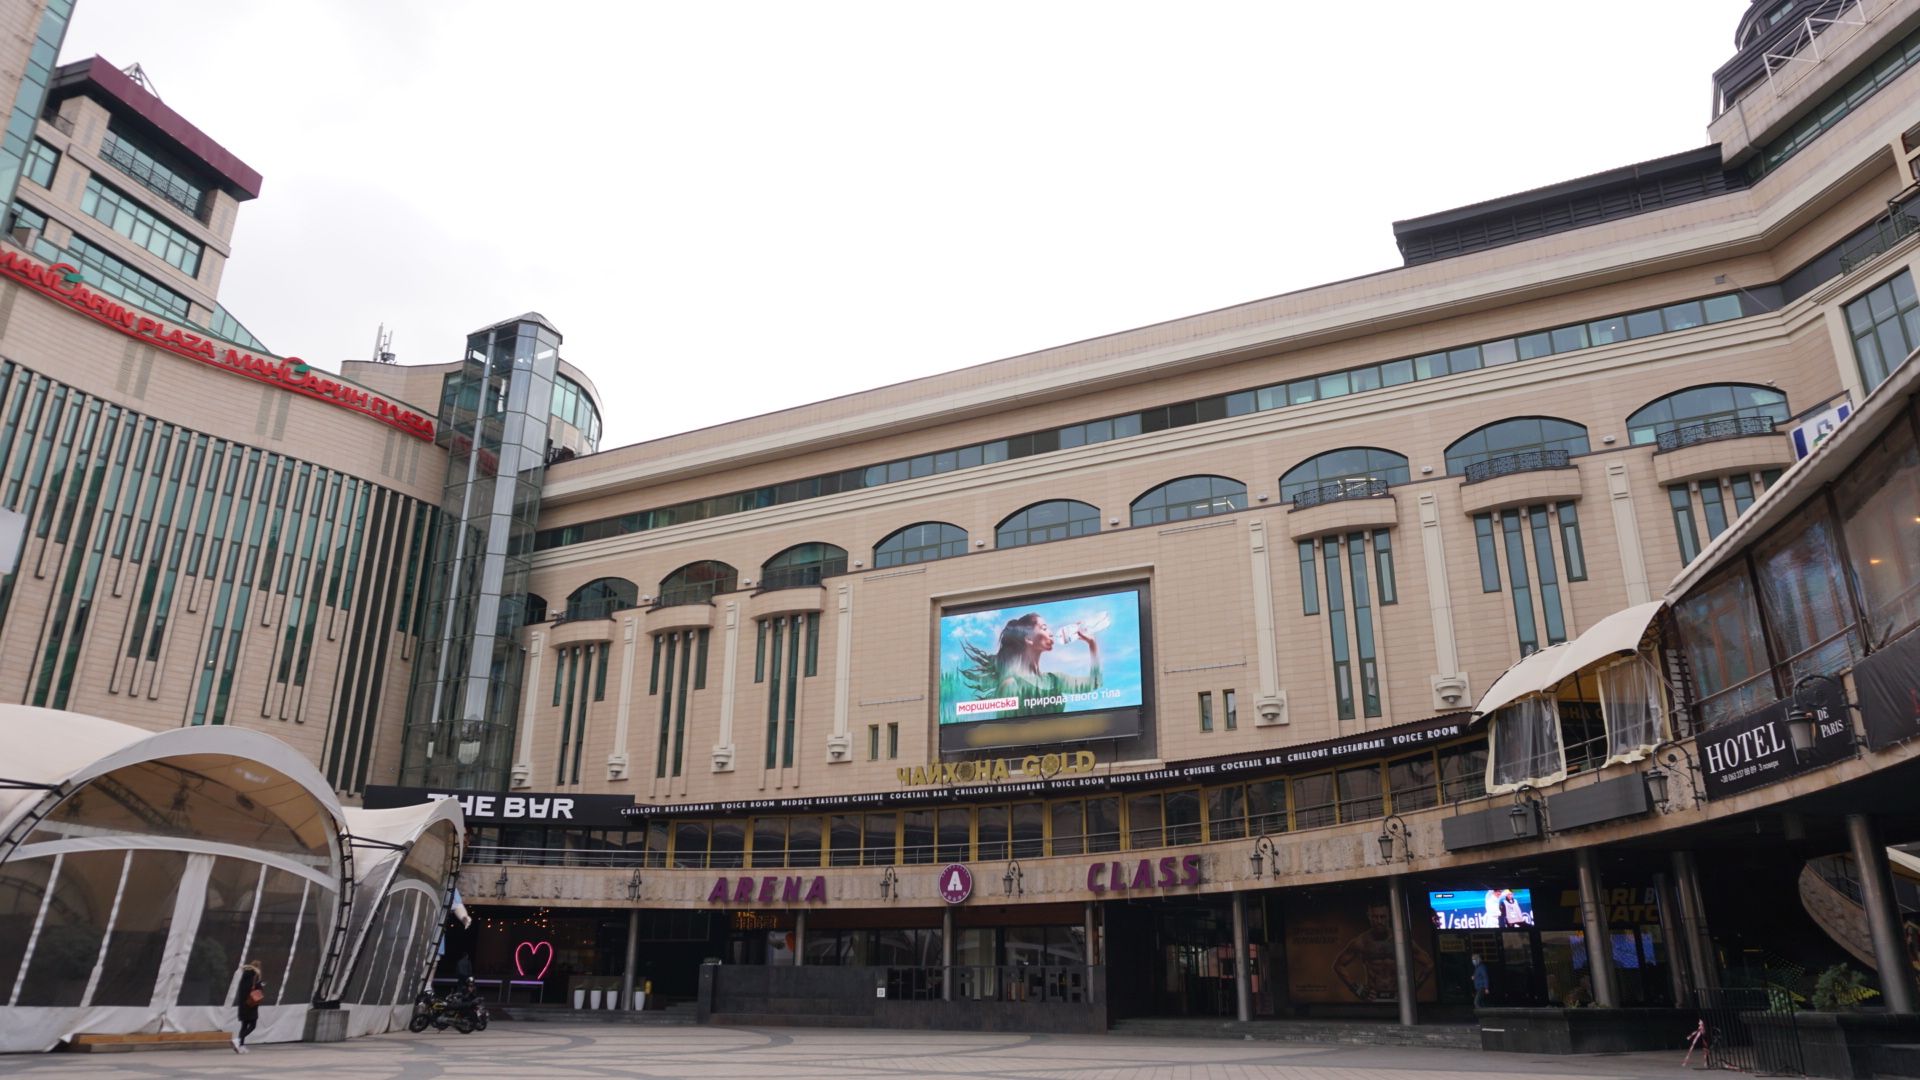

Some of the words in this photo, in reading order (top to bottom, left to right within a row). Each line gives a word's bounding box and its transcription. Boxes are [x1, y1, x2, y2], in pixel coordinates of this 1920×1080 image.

[137, 317, 215, 358] PLAZA
[958, 698, 1017, 713] моршинська
[1024, 694, 1068, 708] природа
[1070, 692, 1098, 702] твого
[1101, 688, 1121, 699] тіла
[1817, 707, 1829, 721] DE
[1820, 719, 1844, 738] PARIS
[1705, 721, 1786, 774] HOTEL
[620, 807, 661, 815] CHILLOUT
[664, 804, 715, 813] RESTAURANT
[750, 800, 776, 808] ROOM
[781, 798, 813, 807] MIDDLE
[815, 796, 849, 805] EASTERN
[852, 794, 884, 802] CUISINE
[890, 792, 929, 800] COCKTAIL
[933, 789, 948, 797] BAR
[955, 786, 994, 796] CHILLOUT
[997, 782, 1046, 793] RESTAURANT
[1051, 780, 1076, 788] VOICE
[1079, 777, 1105, 787] ROOM
[1110, 774, 1142, 784] MIDDLE
[1144, 770, 1180, 781] EASTERN
[1183, 765, 1215, 777] CUISINE
[1220, 758, 1262, 772] COCKTAIL
[1265, 755, 1282, 766] BAR
[1287, 749, 1329, 762] CHILLOUT
[1332, 738, 1386, 755] RESTAURANT
[1392, 732, 1423, 745] VOICE
[1427, 725, 1459, 739] ROOM
[897, 756, 1010, 787] ЧАЙХОНА
[1022, 751, 1096, 778] GOLD
[707, 875, 828, 904] ARENA
[1087, 854, 1202, 895] CLASS
